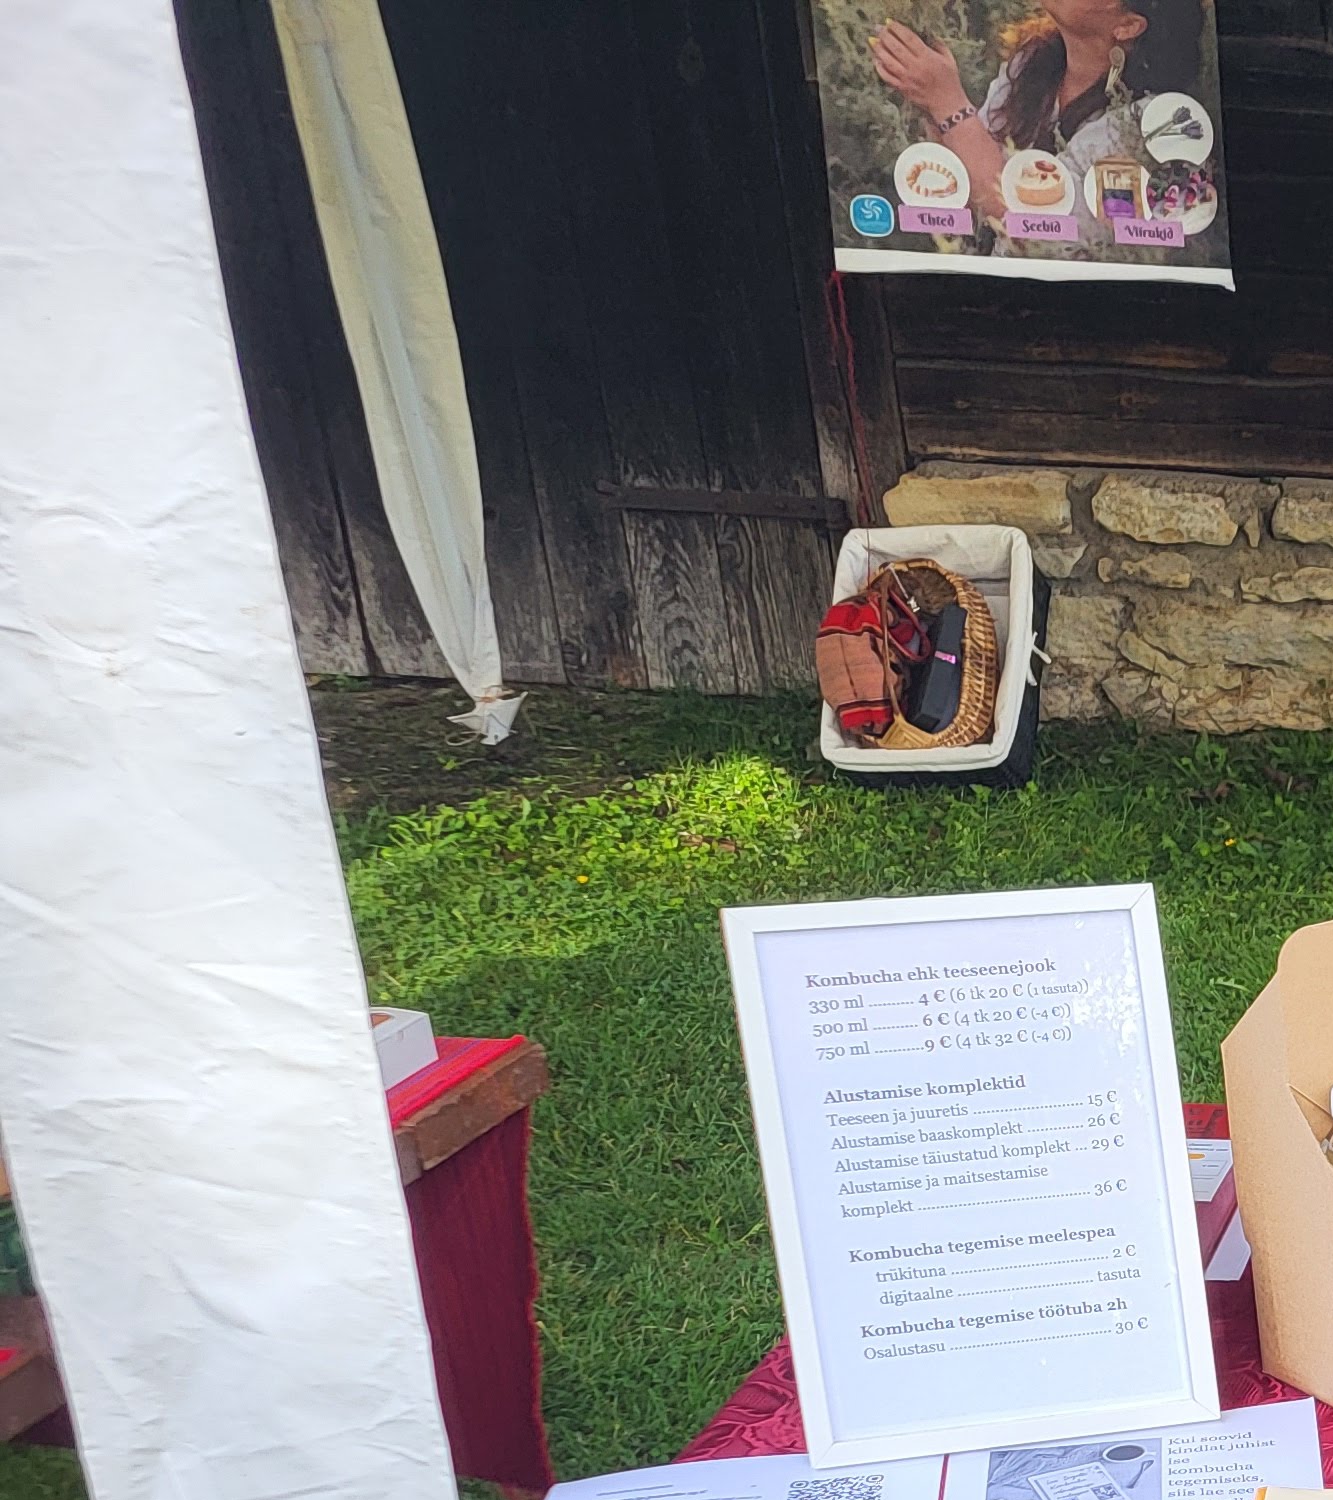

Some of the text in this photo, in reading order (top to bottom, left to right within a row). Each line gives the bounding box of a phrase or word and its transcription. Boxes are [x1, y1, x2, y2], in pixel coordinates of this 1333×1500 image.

[804, 957, 1056, 988] Kombucha ehk teeseenejook
[808, 999, 839, 1014] 330
[843, 994, 864, 1008] ml
[918, 993, 930, 1006] 4
[933, 989, 946, 1002] €
[949, 987, 965, 1003] (6
[969, 985, 985, 999] tk
[988, 987, 1008, 998] 20
[1012, 983, 1023, 996] €
[1041, 978, 1088, 994] tasuta))
[812, 1022, 843, 1037] 500
[847, 1017, 868, 1032] ml
[922, 1013, 932, 1026] 6
[937, 1012, 950, 1025] €
[954, 1010, 970, 1026] (4
[973, 1008, 989, 1022] tk
[992, 1010, 1012, 1021] 20
[1015, 1006, 1027, 1019] €
[815, 1046, 845, 1060] 750
[848, 1040, 870, 1055] ml
[939, 1035, 952, 1048] €
[955, 1033, 971, 1049] (4
[975, 1031, 991, 1045] tk
[994, 1033, 1013, 1047] 32
[1016, 1029, 1028, 1042] €
[823, 1074, 1025, 1104] Alustamise komplektid
[825, 1090, 1117, 1126] Teeseen ja juuretis 15 €
[831, 1112, 1120, 1149] Alustamise baaskomplekt 26 €
[834, 1134, 1124, 1172] Alustamise täiustatud komplekt 29 €
[837, 1164, 1048, 1195] Alustamise ja maitsestamise
[840, 1178, 1127, 1218] komplekt 36 €
[848, 1227, 1115, 1262] Kombucha tegemise meelespea
[875, 1244, 1136, 1282] trükituna 2 €
[879, 1267, 1141, 1306] digitaalne tasuta
[860, 1297, 1127, 1338] Kombucha tegemise töötuba 2h
[863, 1316, 1148, 1359] Osalustasu 30 €
[1167, 1444, 1224, 1455] kindlat
[1168, 1431, 1251, 1445] Kui soovid
[1167, 1457, 1190, 1465] ise
[1168, 1462, 1253, 1475] kombucha
[1167, 1488, 1195, 1497] siis
[1199, 1487, 1224, 1495] lae
[1168, 1474, 1263, 1486] tegemiseks,
